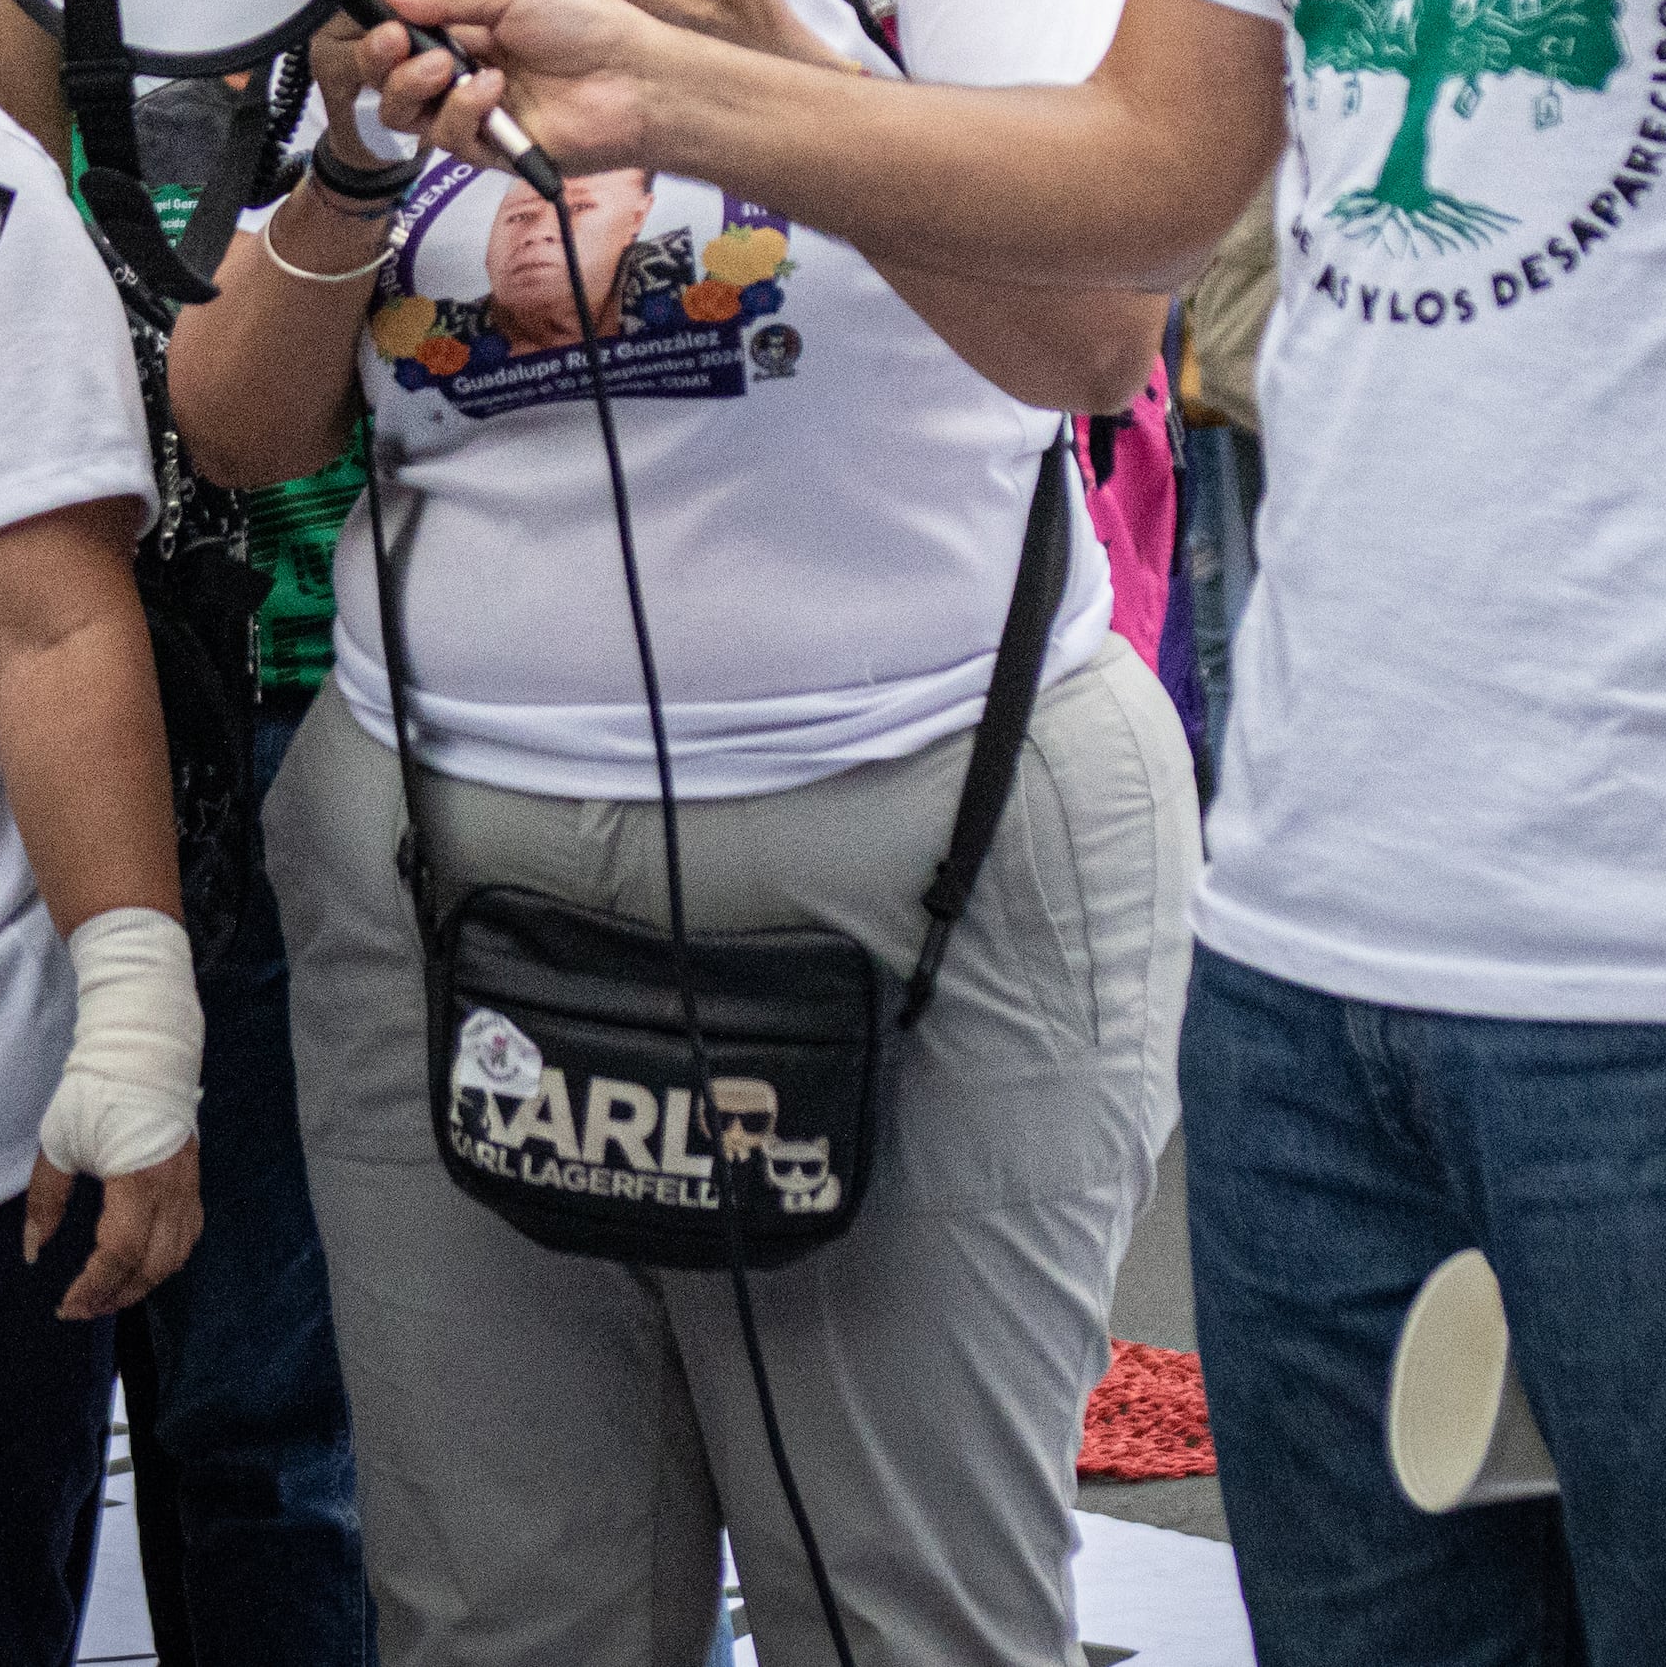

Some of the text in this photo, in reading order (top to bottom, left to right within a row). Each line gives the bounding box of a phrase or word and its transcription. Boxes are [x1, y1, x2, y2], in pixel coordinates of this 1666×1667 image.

[452, 329, 721, 397] Guadalupe Ruz González
